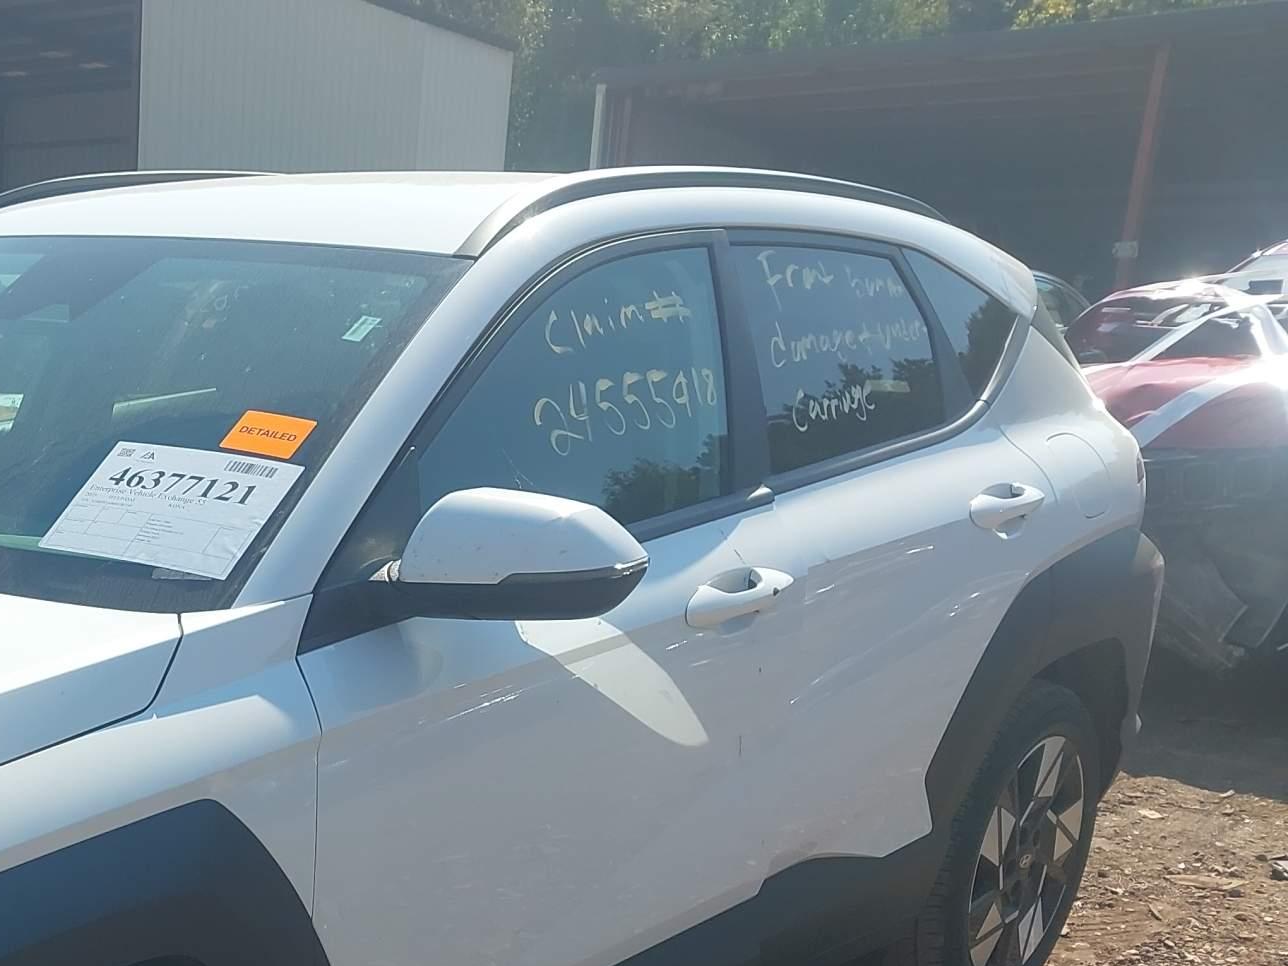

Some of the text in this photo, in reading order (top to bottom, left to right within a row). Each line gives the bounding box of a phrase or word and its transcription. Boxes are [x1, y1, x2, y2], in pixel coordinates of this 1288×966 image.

[534, 368, 716, 456] 24555918
[239, 425, 297, 441] DETAILED
[89, 484, 127, 494] Enterprise
[129, 488, 157, 499] Vehicle
[158, 492, 195, 505] Exchange
[109, 466, 256, 505] 46377121
